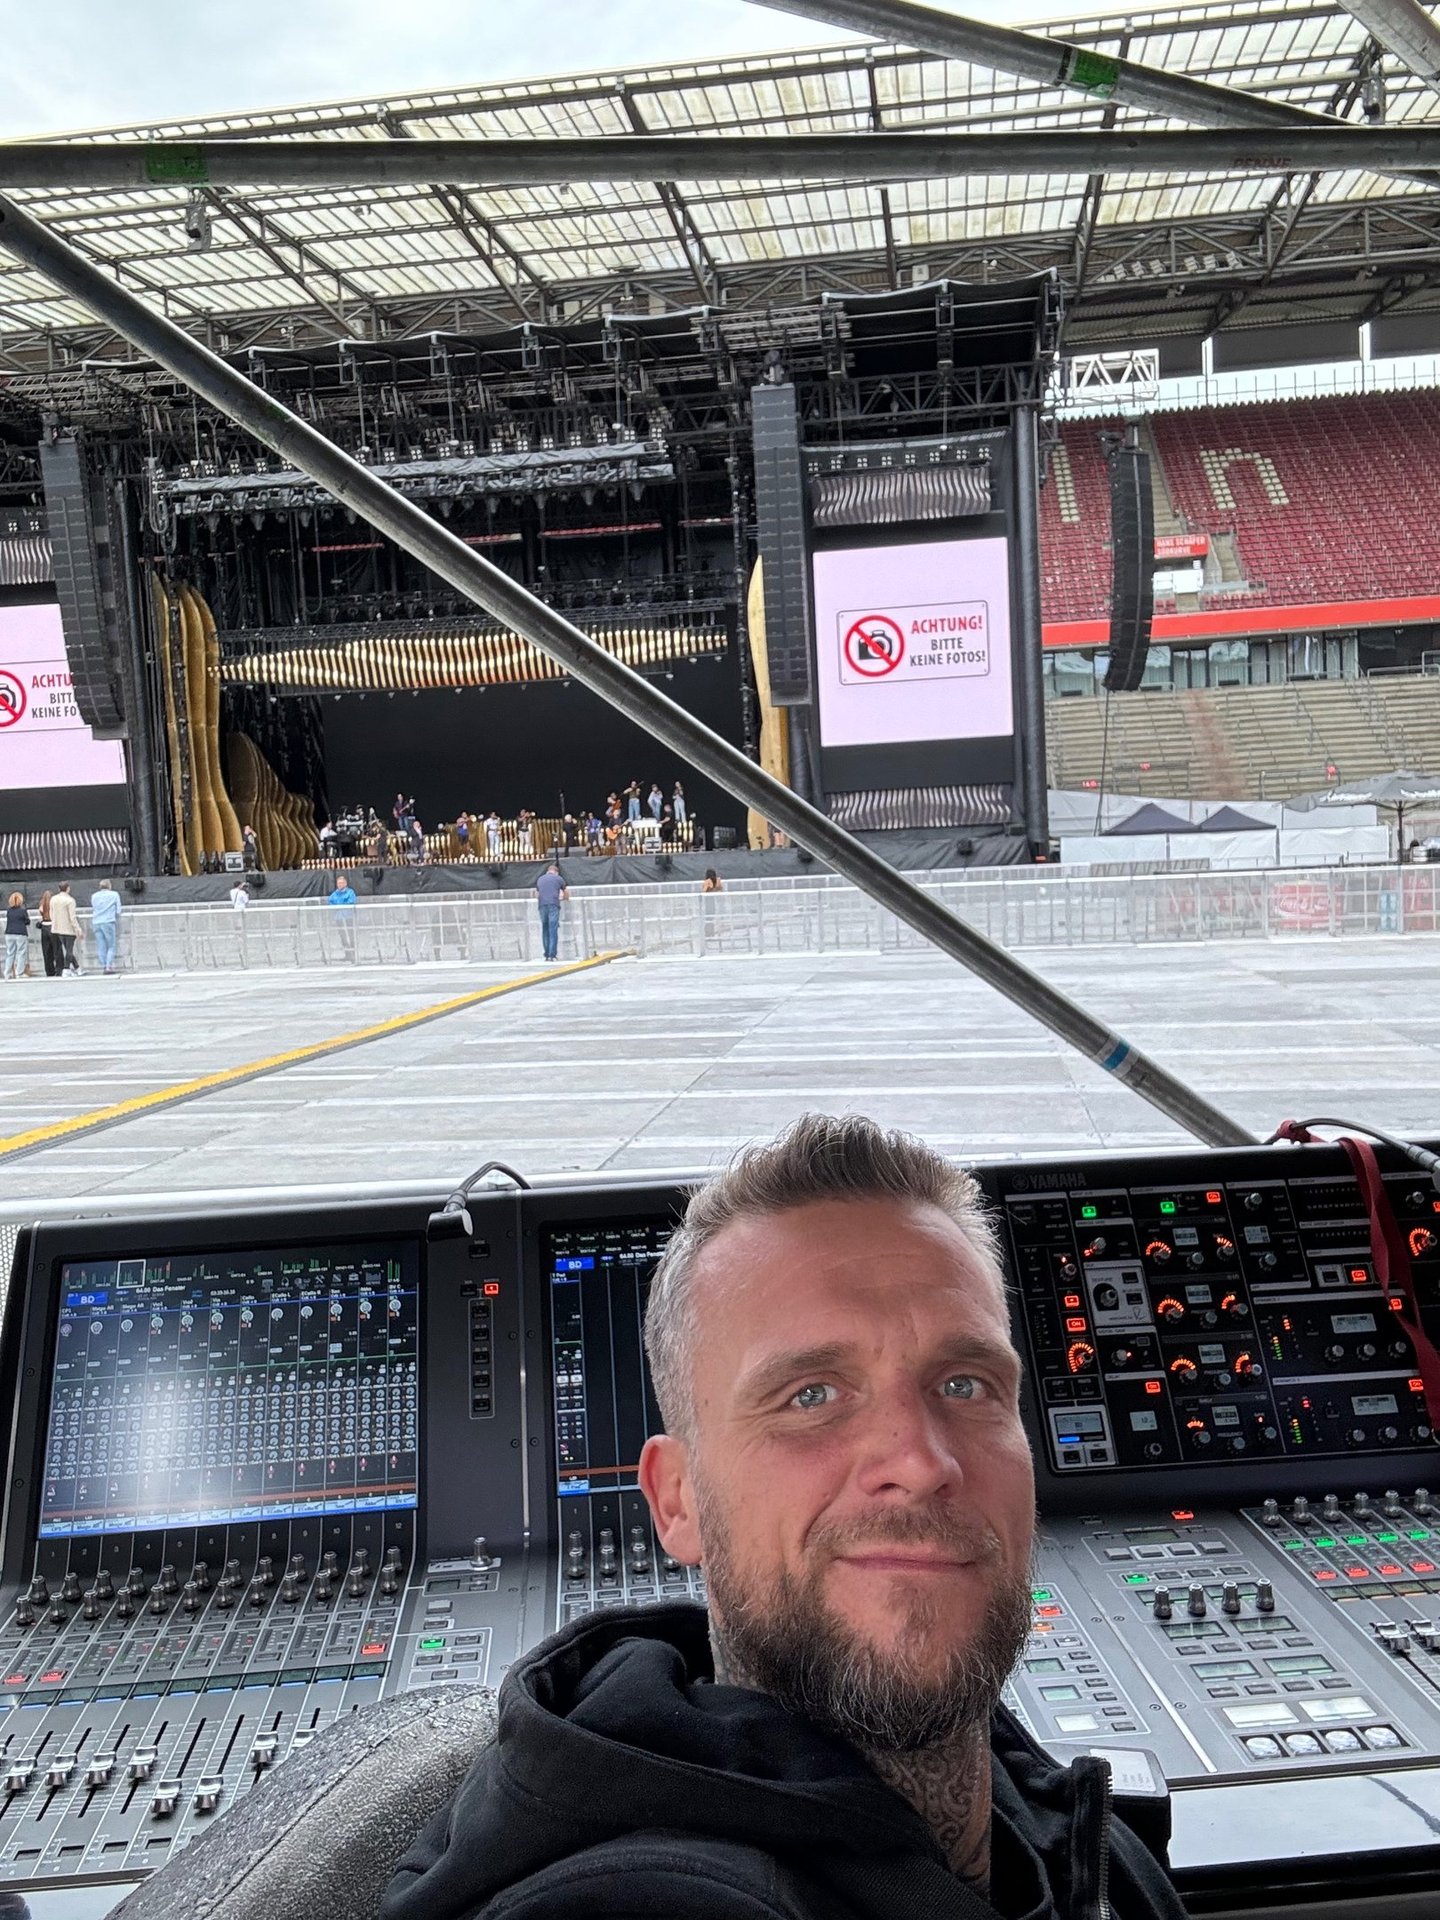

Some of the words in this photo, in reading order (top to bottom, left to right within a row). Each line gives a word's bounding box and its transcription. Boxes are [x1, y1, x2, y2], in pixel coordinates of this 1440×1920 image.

[911, 615, 983, 634] ACHTUNG!
[931, 637, 963, 651] BITTE
[910, 653, 943, 667] KEINE
[946, 650, 985, 664] FOTOS!
[32, 673, 74, 688] ACHTU
[50, 692, 73, 704] BITT
[32, 706, 61, 719] KEINE
[64, 705, 77, 717] FO
[1030, 1172, 1087, 1189] YAMAHA
[568, 1260, 582, 1269] BD
[80, 1295, 95, 1304] BD
